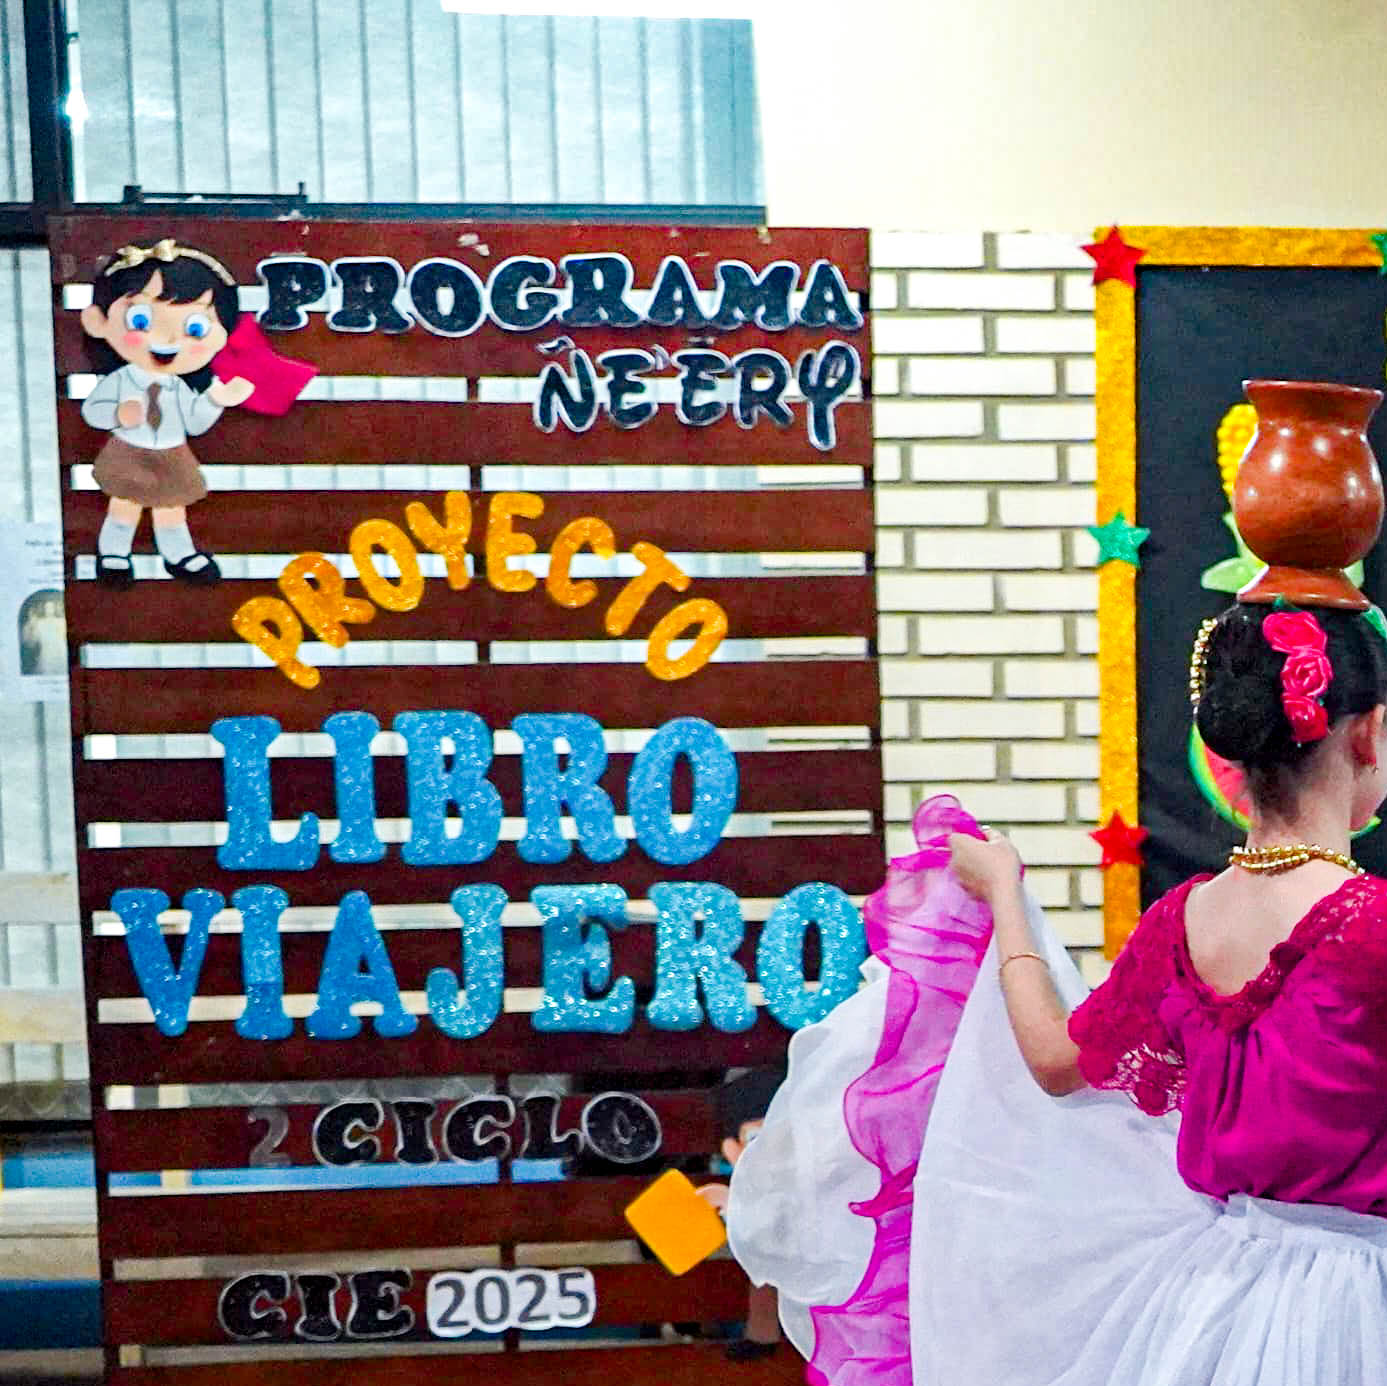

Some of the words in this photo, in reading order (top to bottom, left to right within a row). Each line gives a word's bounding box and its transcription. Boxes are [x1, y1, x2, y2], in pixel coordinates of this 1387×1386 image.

[256, 252, 866, 337] PROGRAMA
[232, 491, 729, 689] PROYECTO
[211, 712, 742, 871] LIBRO
[110, 881, 867, 1041] VIAJERO
[245, 1109, 293, 1169] 2
[311, 1091, 662, 1167] CICLO
[217, 1269, 415, 1341] CIE
[430, 1269, 595, 1335] 2025
